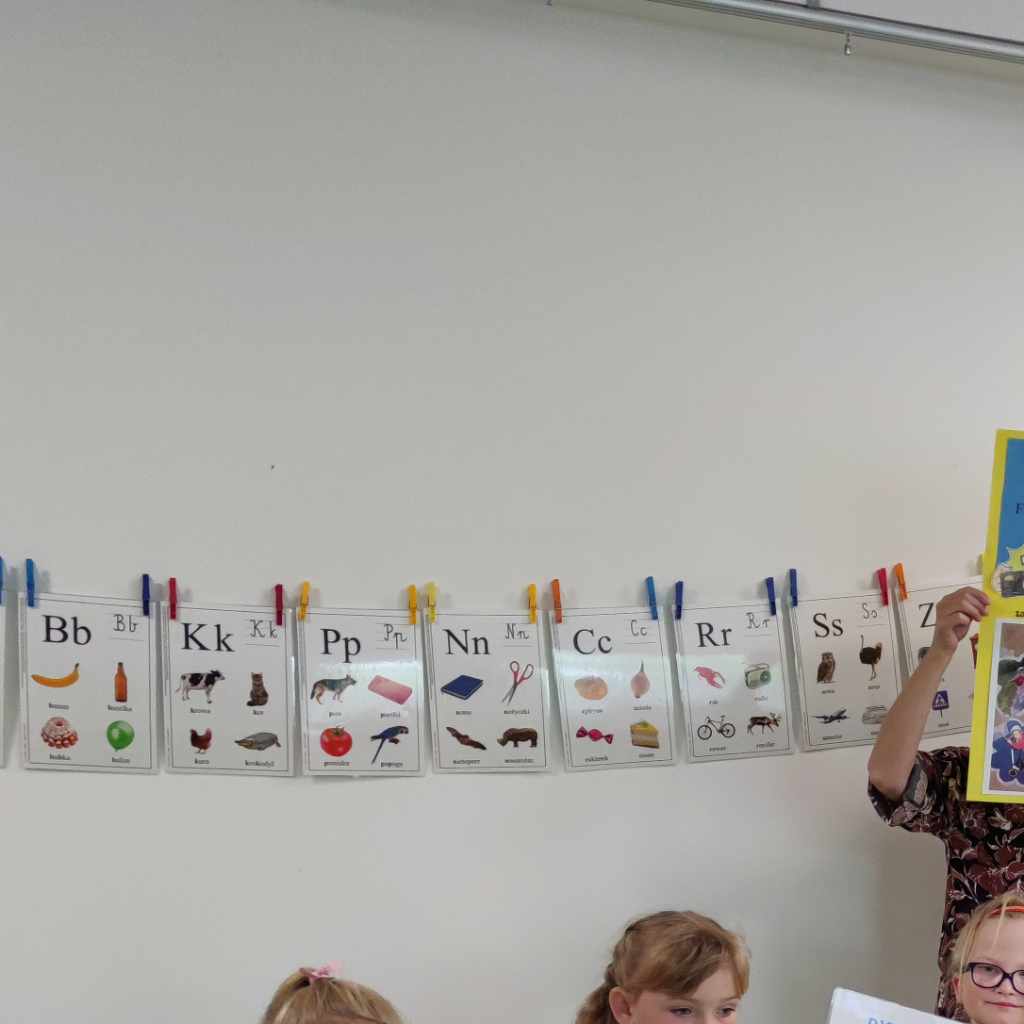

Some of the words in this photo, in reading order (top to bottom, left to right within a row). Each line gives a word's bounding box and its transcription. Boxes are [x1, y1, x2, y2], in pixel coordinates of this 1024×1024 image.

[746, 612, 770, 629] Rr
[861, 602, 878, 619] Ss
[42, 614, 92, 645] Bb
[114, 614, 138, 633] Bb
[250, 619, 278, 639] Kk
[505, 623, 529, 639] Nn
[631, 620, 647, 636] Cc
[695, 622, 733, 647] Rr
[813, 613, 844, 638] Ss
[181, 623, 235, 652] Kk
[321, 628, 361, 663] Pp
[384, 624, 407, 649] Pp
[443, 629, 490, 655] Nn
[573, 629, 613, 655] Cc
